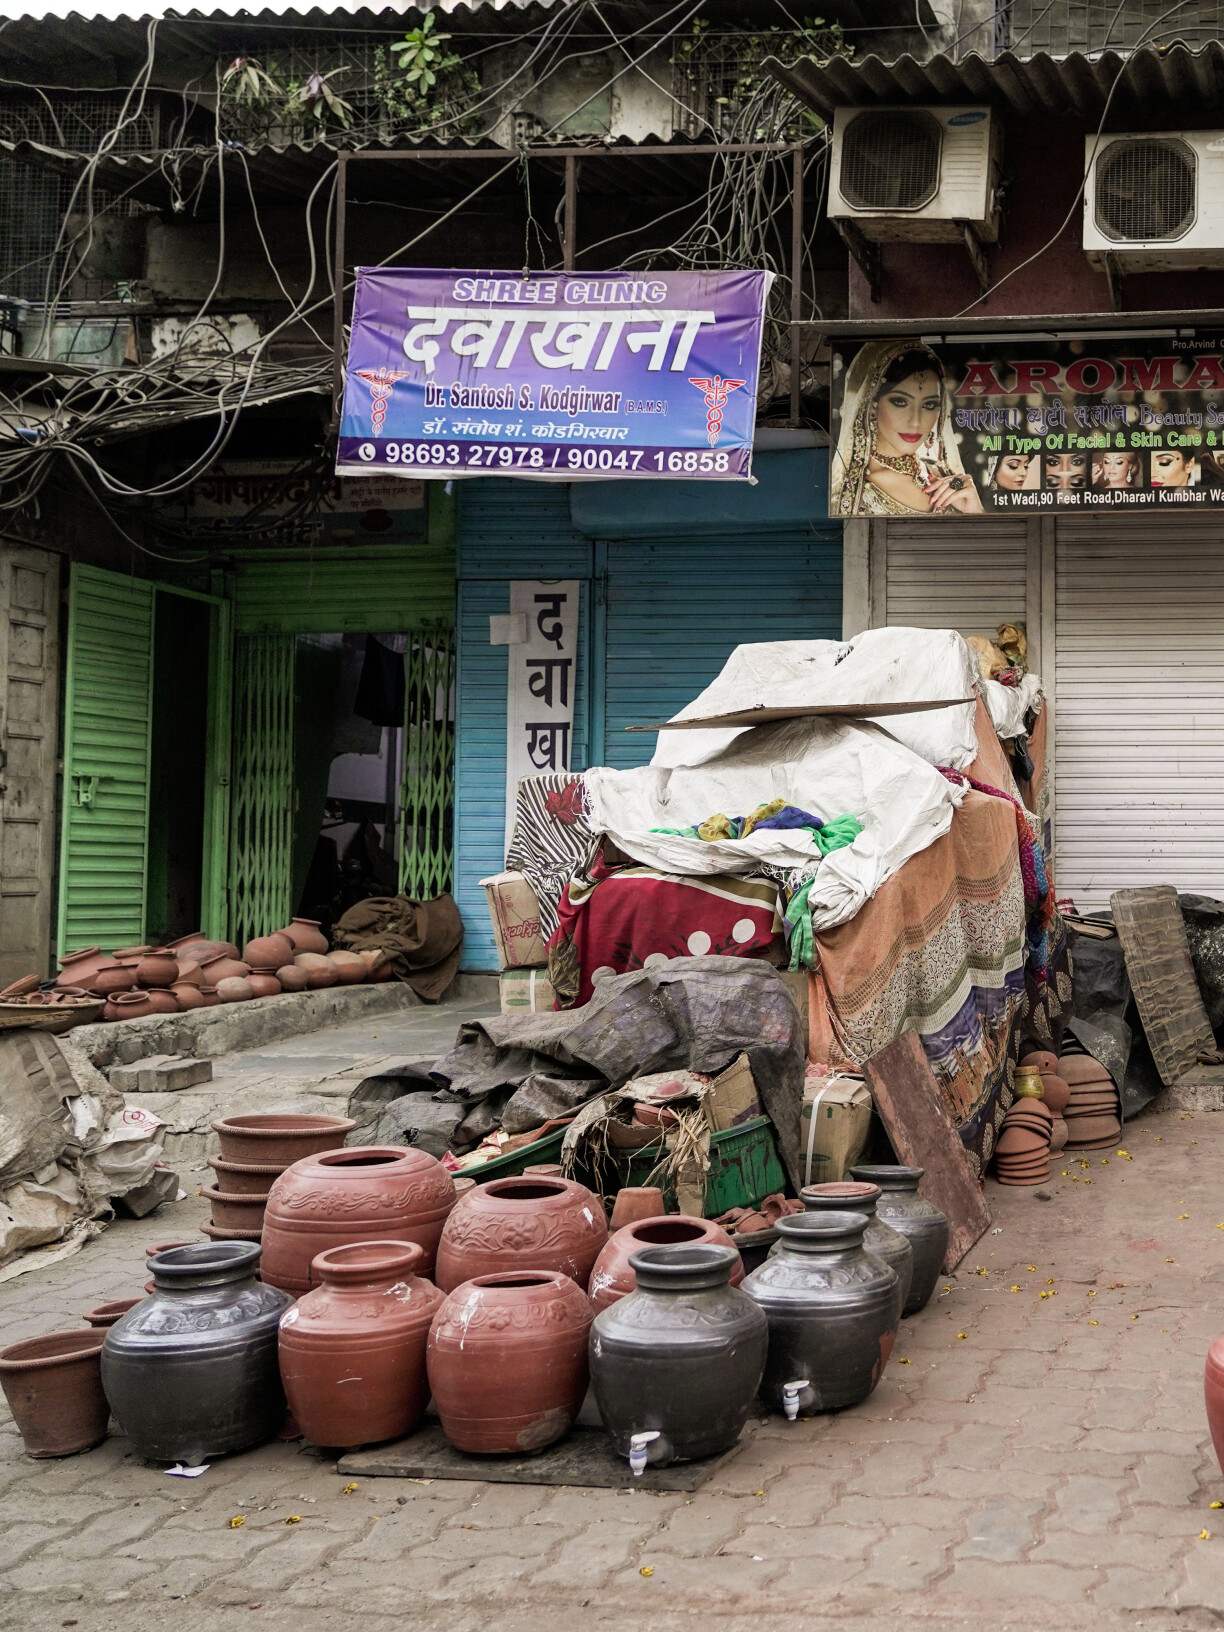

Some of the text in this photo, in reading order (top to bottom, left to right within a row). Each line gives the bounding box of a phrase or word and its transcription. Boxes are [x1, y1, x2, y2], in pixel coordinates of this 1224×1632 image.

[452, 278, 668, 304] SHREE CLINIC
[401, 306, 716, 372] दवाखाना
[1172, 339, 1216, 349] Pro.Arvind
[424, 381, 669, 418] Dr. Santosh S. Kodgirwar (B.A.M.S.)
[422, 417, 629, 440] डॉ. संतोष शं. कोडगिरवार
[955, 401, 1021, 432] आरोमा
[1139, 403, 1203, 429] Beauty
[982, 435, 1002, 451] All
[1006, 435, 1042, 454] Type
[1045, 433, 1064, 449] Of
[1067, 433, 1111, 448] Facial
[1114, 432, 1127, 447] &
[1130, 432, 1163, 448] Skin
[1166, 431, 1202, 447] Care
[1206, 430, 1218, 447] &
[385, 443, 730, 473] 98693 27978 / 90047 16858
[992, 493, 1009, 506] 1st
[1011, 492, 1054, 507] Wadi,90
[1057, 492, 1081, 505] Feet
[1083, 490, 1156, 505] Road,Dharavi
[1158, 489, 1206, 503] Kumbhar
